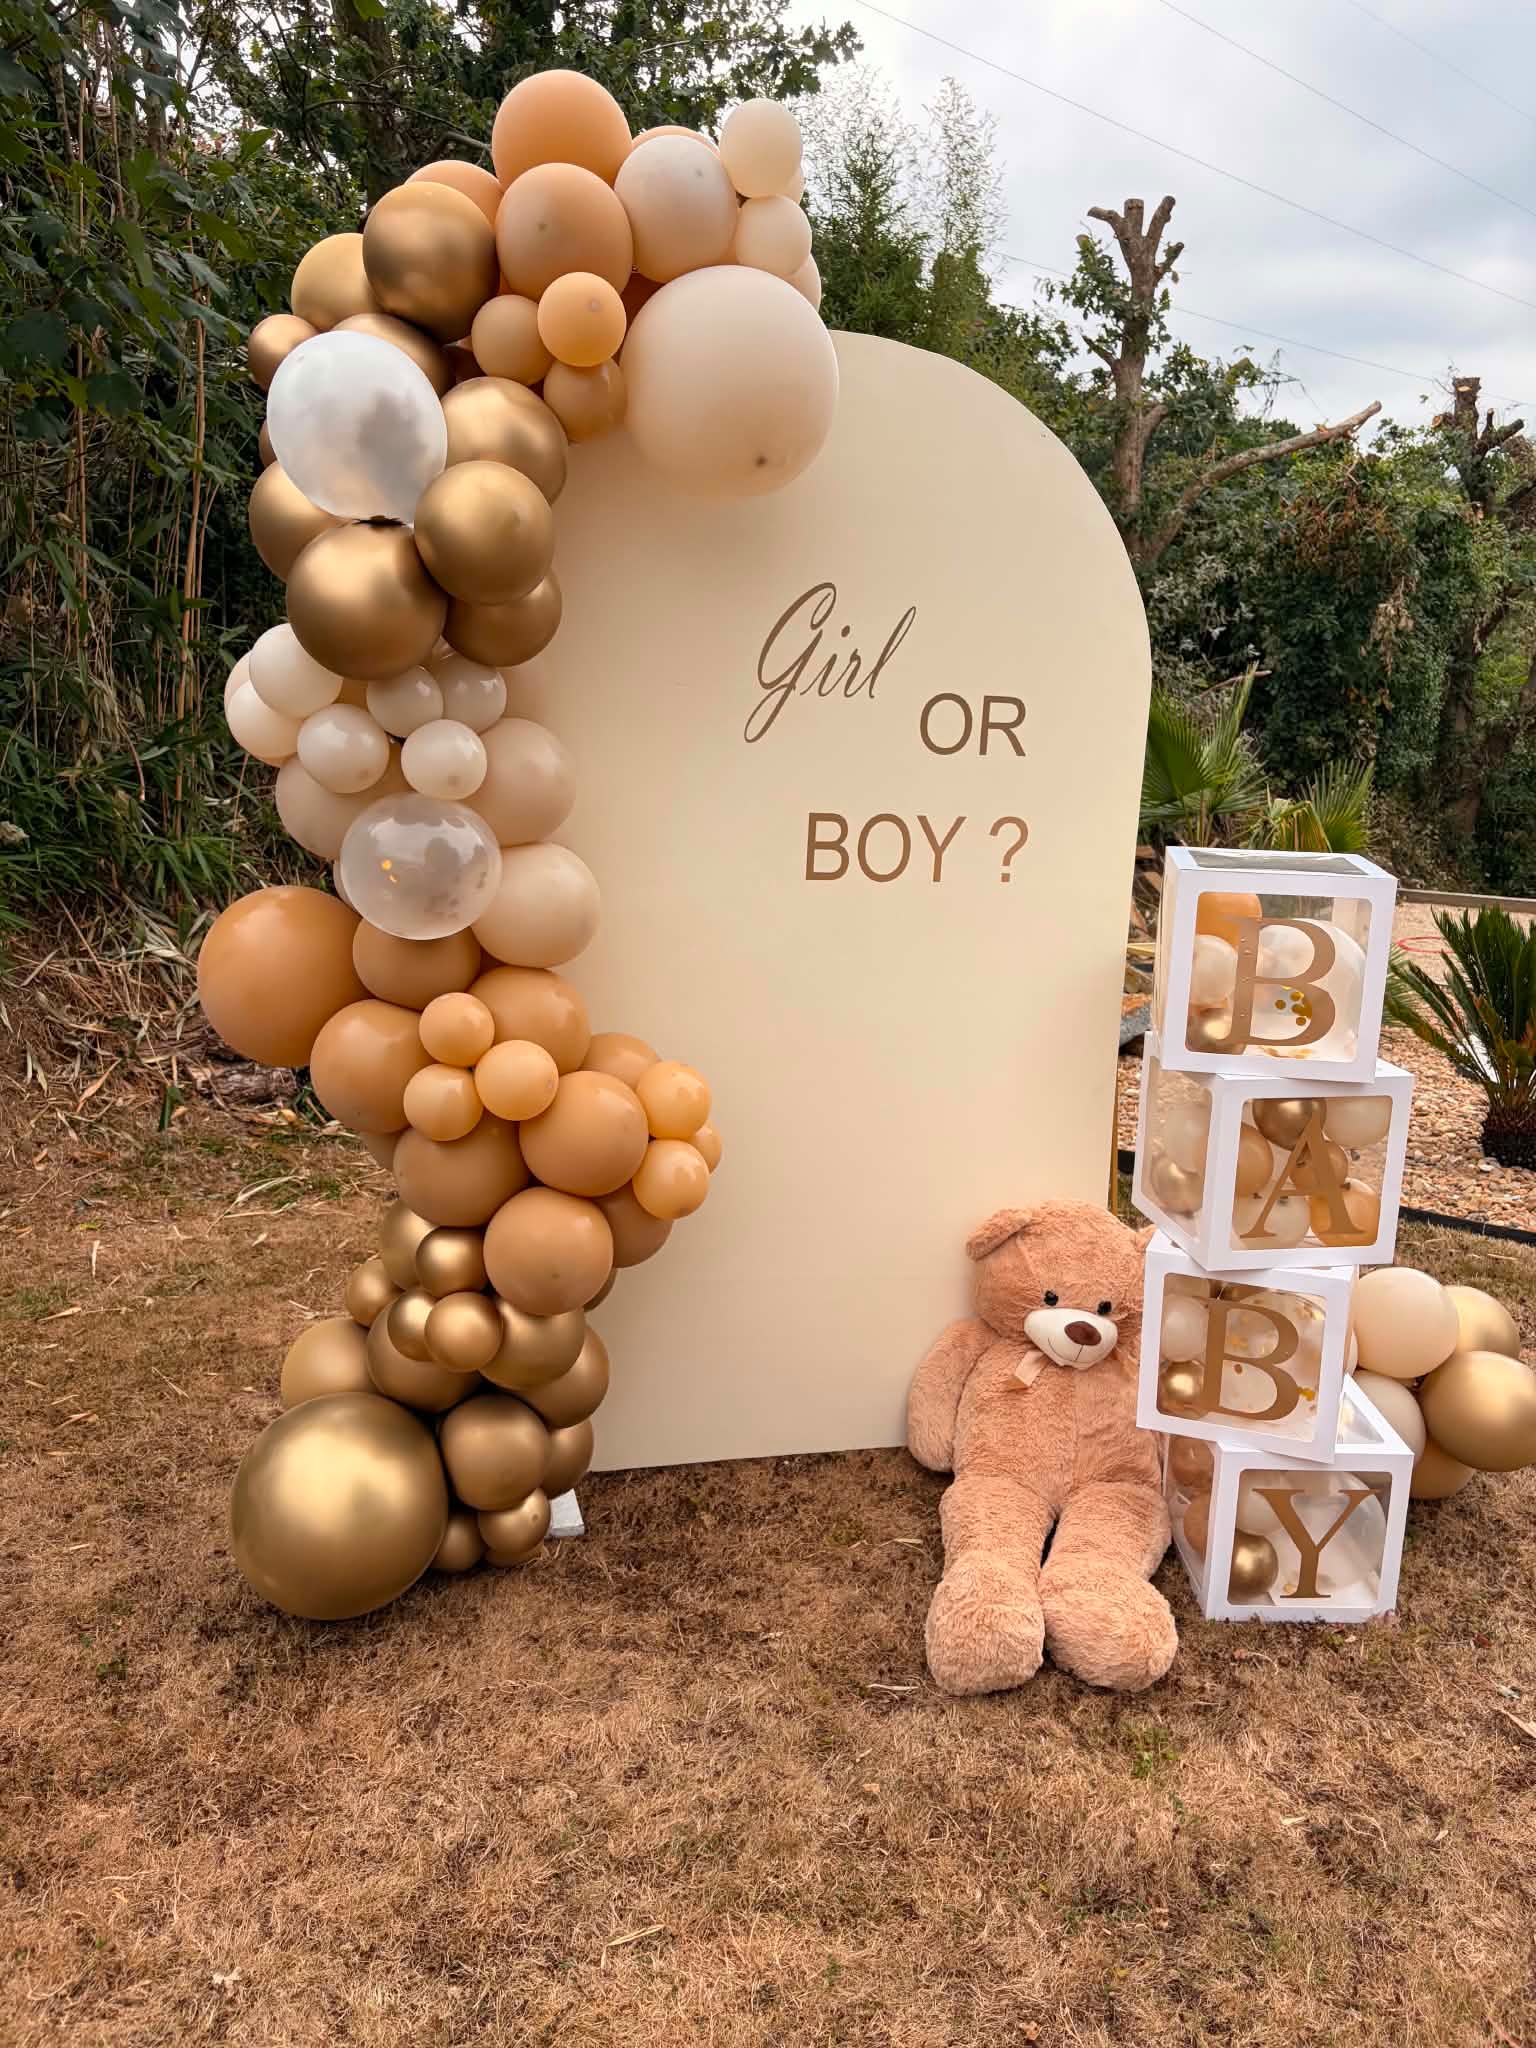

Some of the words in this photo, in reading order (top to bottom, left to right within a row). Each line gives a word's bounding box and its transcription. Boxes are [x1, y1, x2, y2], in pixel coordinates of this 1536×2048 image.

[743, 581, 917, 744] Girl
[919, 692, 1027, 757] OR
[805, 812, 968, 883] BOY
